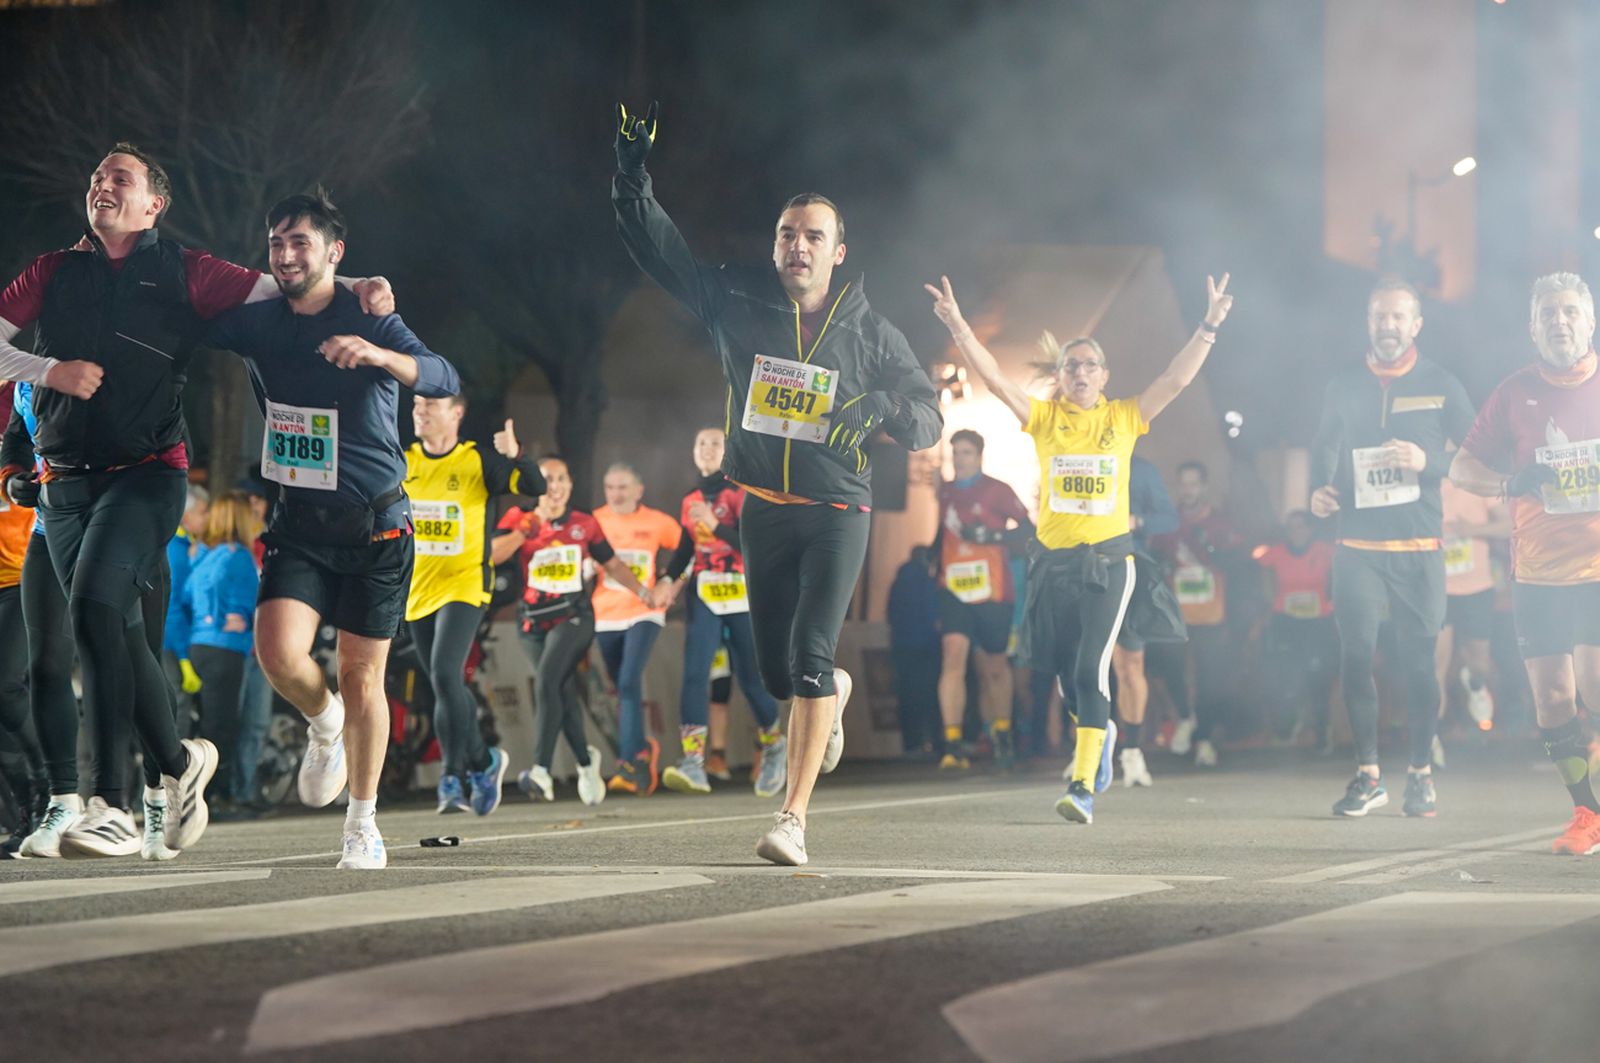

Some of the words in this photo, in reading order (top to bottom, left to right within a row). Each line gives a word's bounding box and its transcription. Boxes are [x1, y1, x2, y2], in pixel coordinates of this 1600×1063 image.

[761, 374, 777, 384] SAN
[771, 366, 795, 378] NOCHE
[796, 371, 807, 380] DE
[764, 386, 817, 415] 4547
[275, 432, 325, 461] 3189
[1554, 450, 1578, 459] NOCHE
[1580, 448, 1588, 456] DE
[1063, 476, 1105, 494] 8805
[1367, 468, 1403, 486] 4124
[416, 520, 452, 536] 5882
